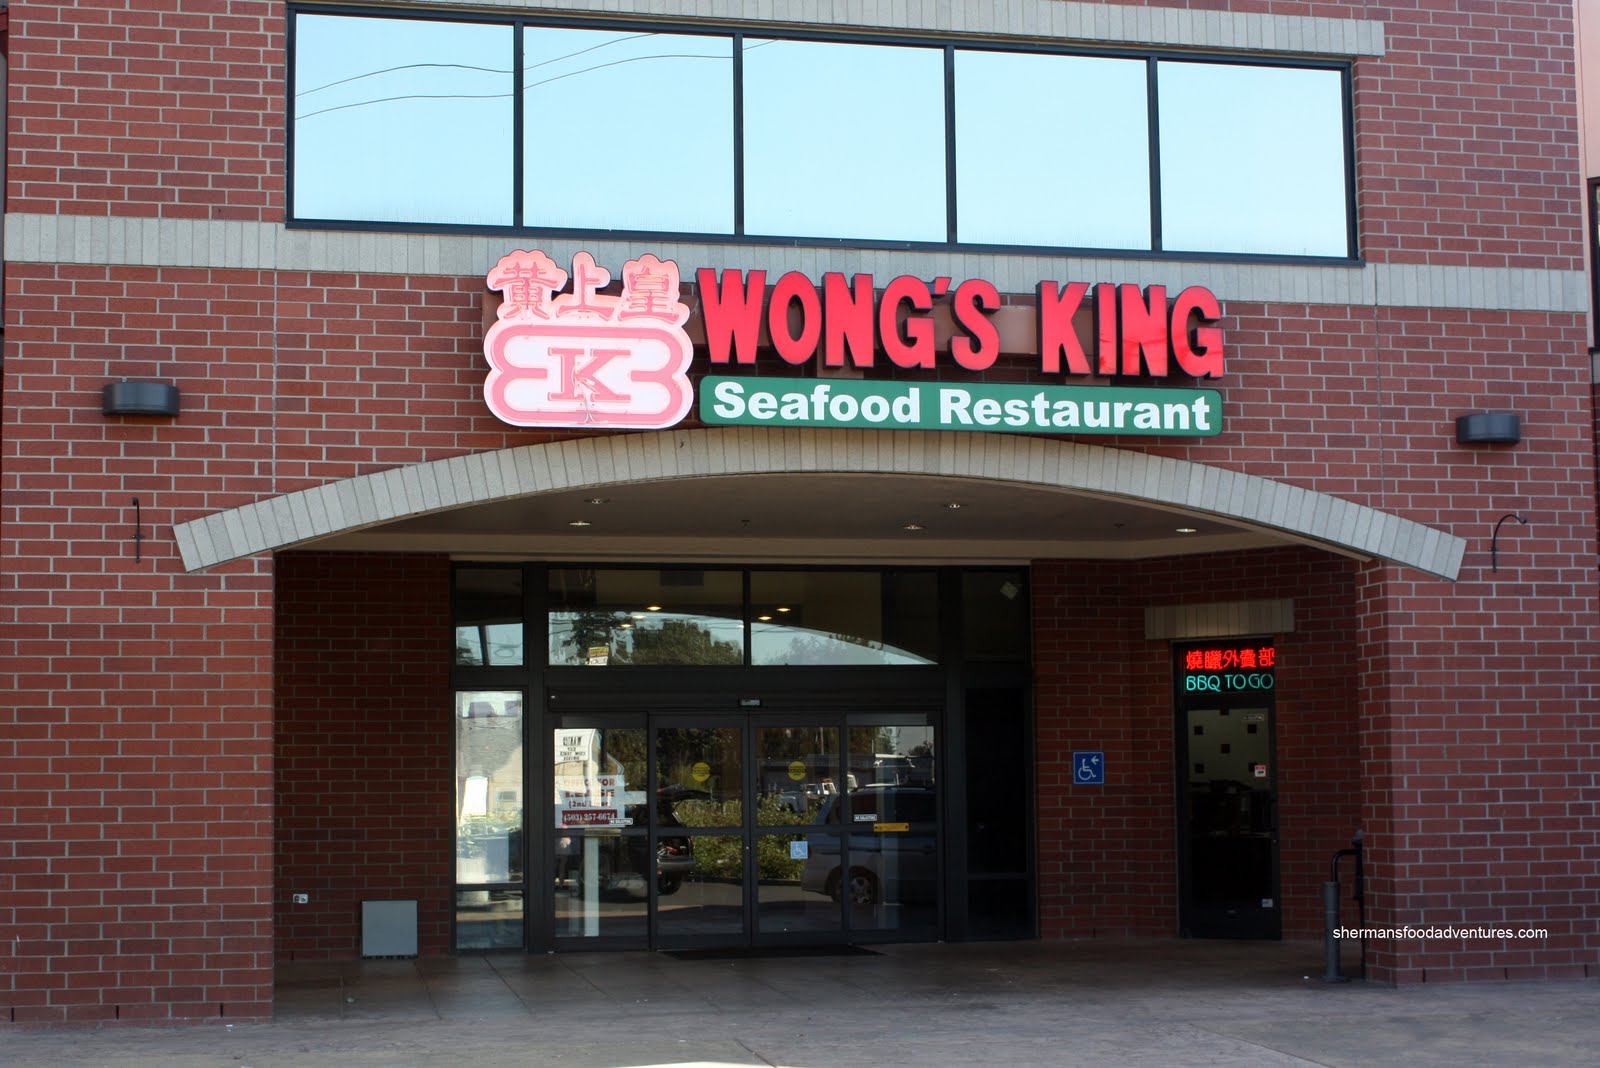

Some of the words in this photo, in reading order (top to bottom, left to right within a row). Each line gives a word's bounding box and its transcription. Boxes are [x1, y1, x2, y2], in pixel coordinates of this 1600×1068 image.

[696, 267, 1001, 371] WONG'S
[1038, 279, 1225, 378] KING
[548, 347, 631, 403] K
[713, 381, 920, 424] Seafood
[939, 388, 1211, 431] Restaurant
[1186, 675, 1221, 692] BBQ
[1224, 674, 1247, 690] TO
[1248, 673, 1274, 690] GO
